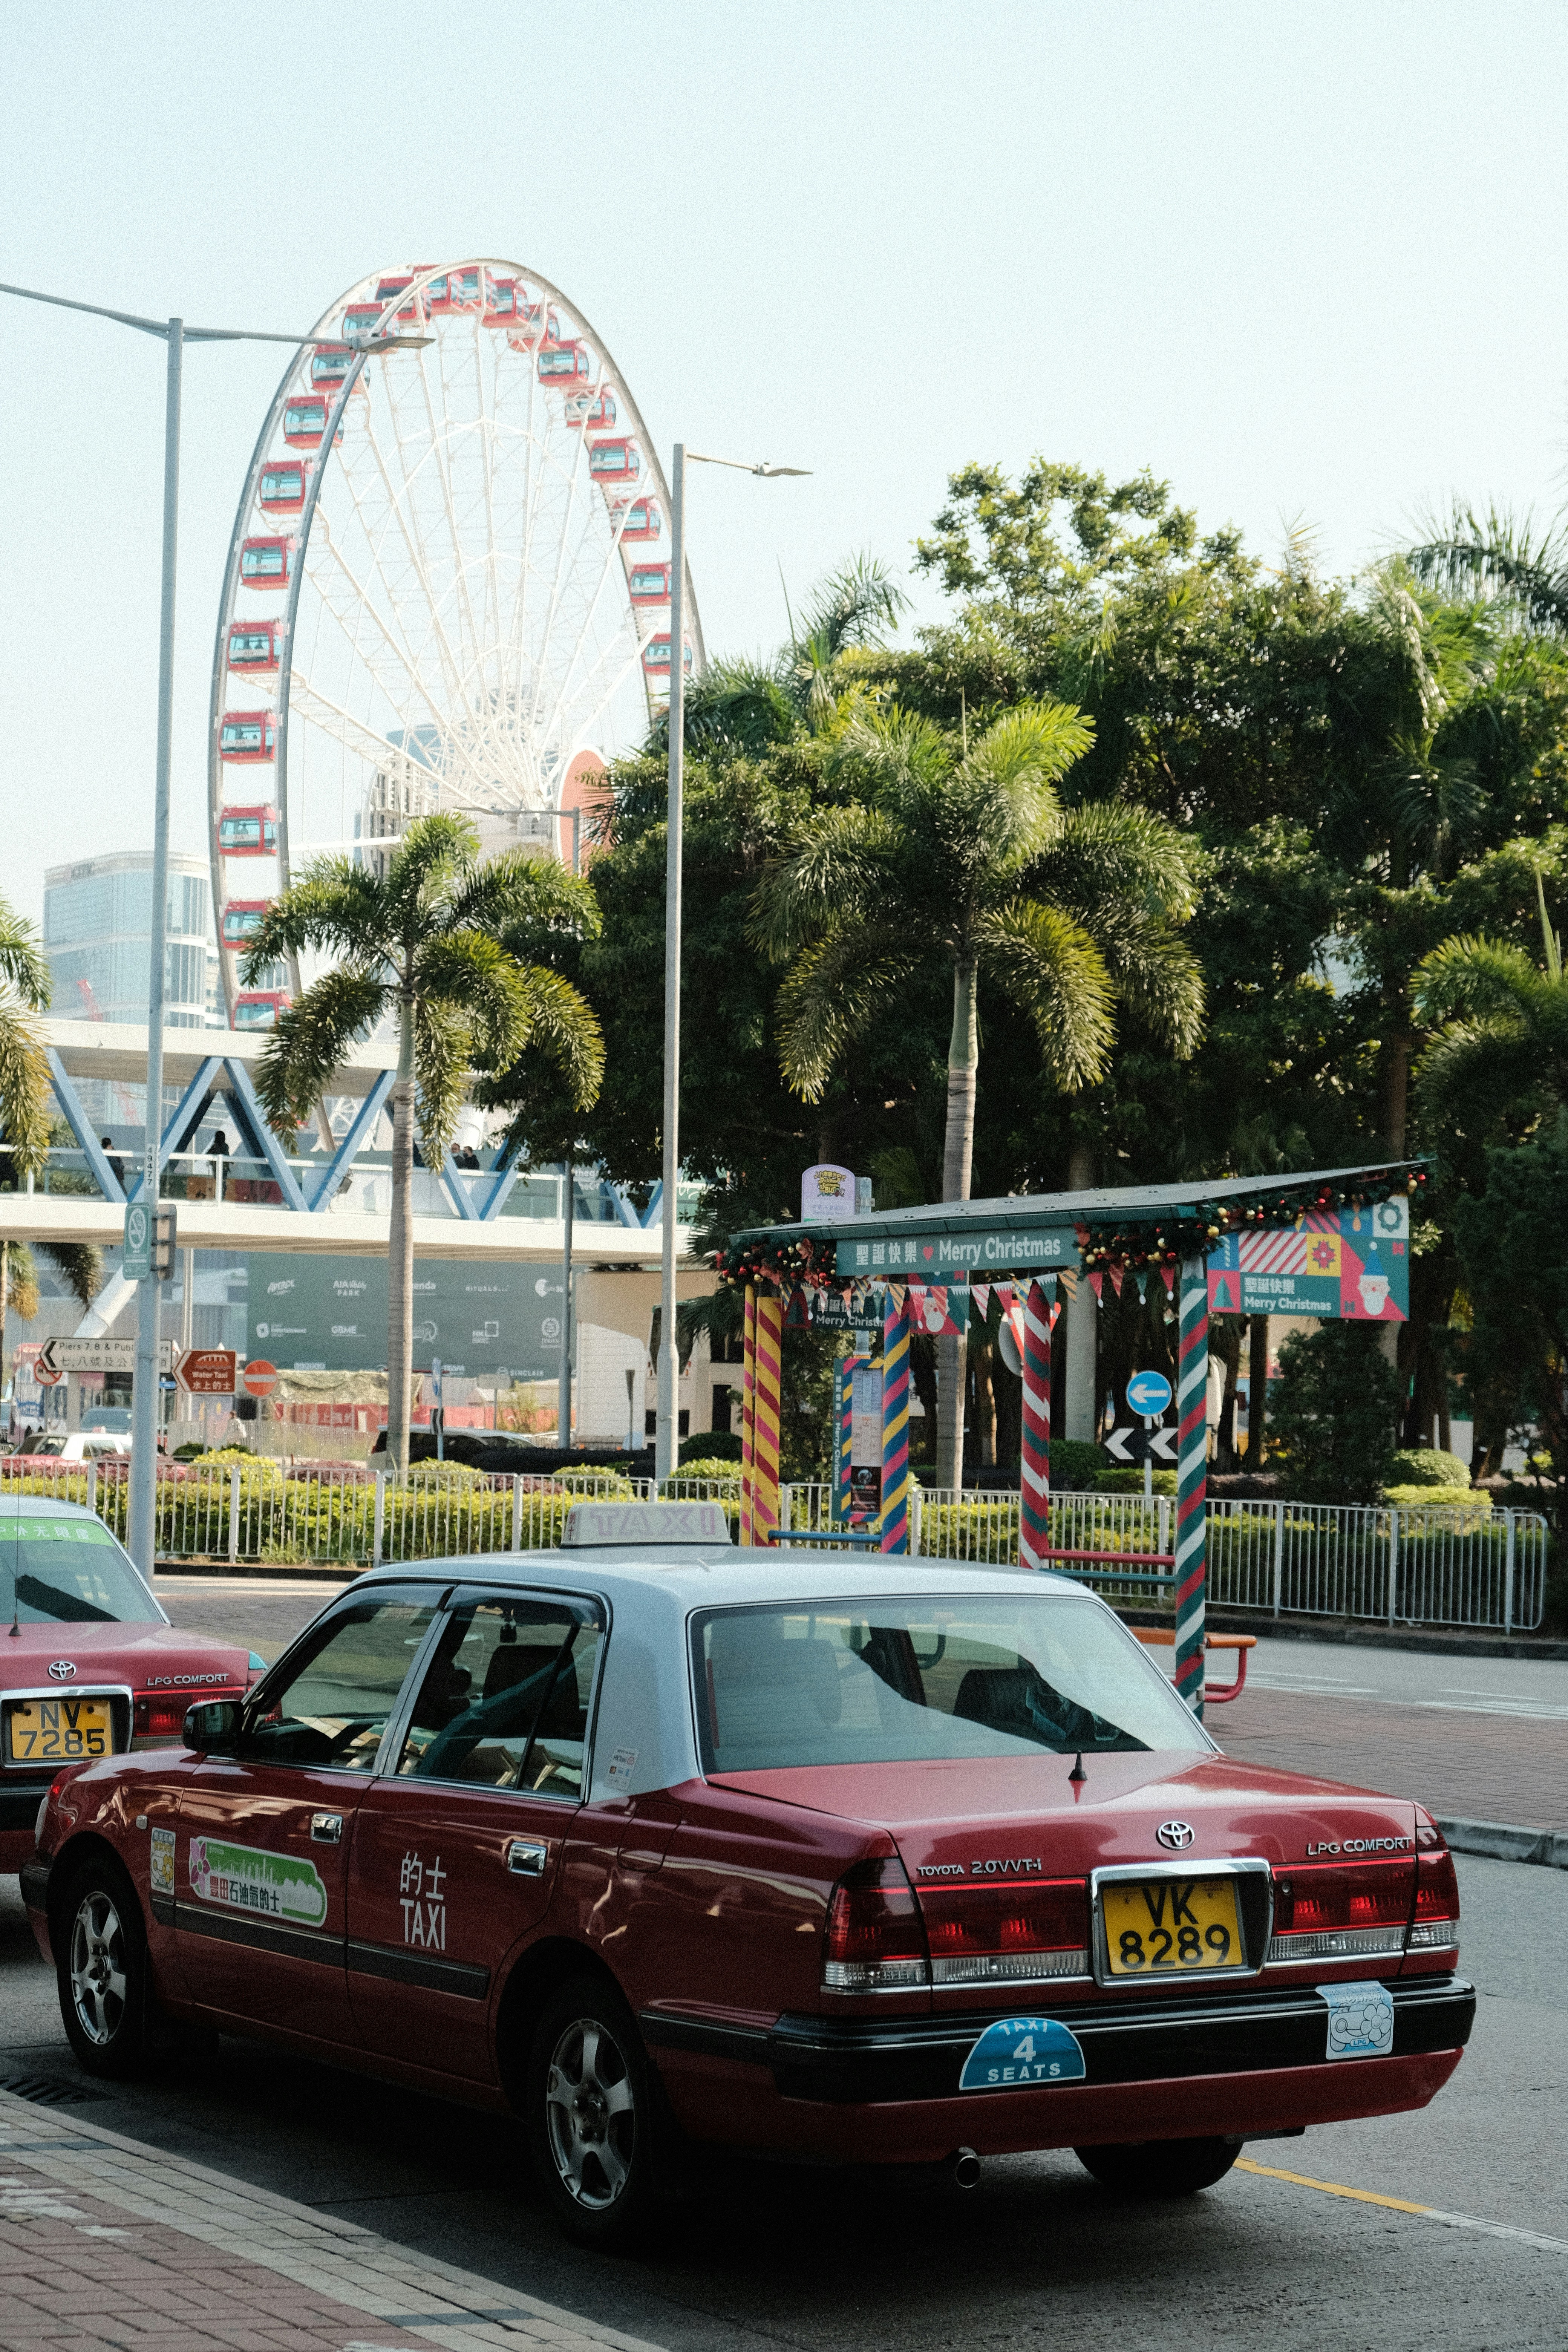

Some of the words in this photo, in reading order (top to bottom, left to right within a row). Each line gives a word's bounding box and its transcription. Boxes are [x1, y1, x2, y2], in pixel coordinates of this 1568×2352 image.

[856, 1242, 917, 1266] 聖誕快樂
[939, 1240, 981, 1266] Merry
[985, 1235, 1061, 1260] Christmas
[333, 1280, 348, 1289] AIA
[1244, 1277, 1295, 1295] 聖誕快樂
[1244, 1296, 1276, 1312] Merry
[1278, 1298, 1332, 1311] Christmas
[816, 1315, 846, 1328] Merry
[848, 1316, 885, 1327] Christm
[59, 1343, 81, 1351] Piers
[114, 1343, 135, 1351] Publ
[192, 1381, 232, 1390] 水上的士
[590, 1507, 715, 1536] TAXI
[147, 1677, 172, 1686] LPG
[173, 1673, 229, 1685] COMFORT
[40, 1703, 81, 1730] NV
[19, 1729, 106, 1757] 7285
[1307, 1841, 1340, 1856] LPG
[1343, 1837, 1413, 1853] COMFORT
[400, 1851, 447, 1901] 的士
[917, 1865, 965, 1876] TOYOTA
[210, 1875, 280, 1913] 豐田石油氣的士
[1142, 1884, 1198, 1927] VK
[400, 1899, 446, 1951] TAXI
[1119, 1924, 1230, 1970] 8289
[998, 2019, 1047, 2036] TAXI
[1013, 2035, 1036, 2062] 4
[987, 2063, 1061, 2082] SEATS
